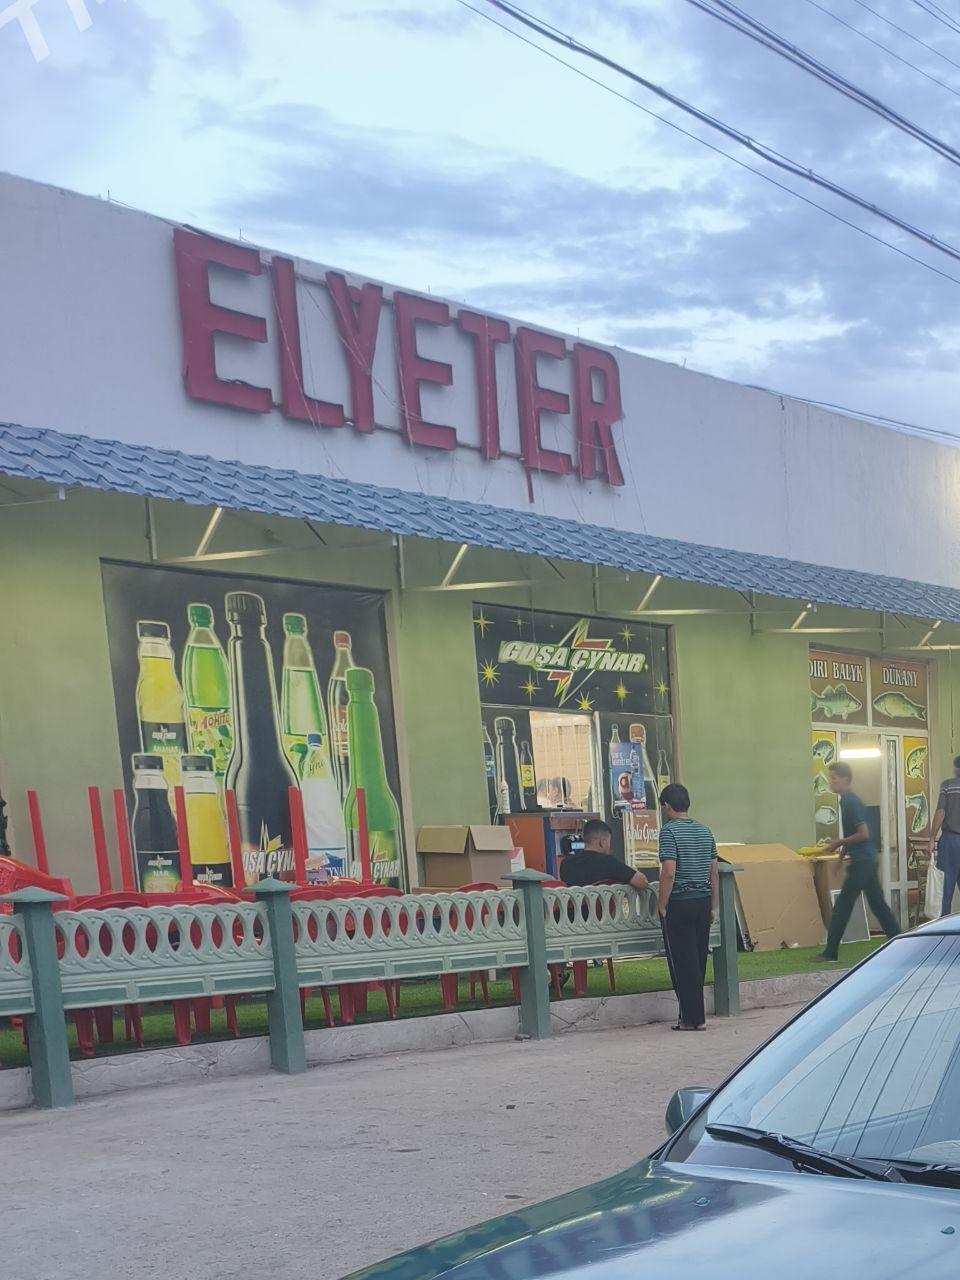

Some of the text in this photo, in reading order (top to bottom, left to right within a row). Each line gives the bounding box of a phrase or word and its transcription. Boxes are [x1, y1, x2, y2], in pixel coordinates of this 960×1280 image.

[173, 228, 625, 487] ELYETER
[503, 641, 645, 672] GOŞA ÇYNAR
[832, 662, 864, 683] BALYK
[882, 664, 919, 687] DÜKANY
